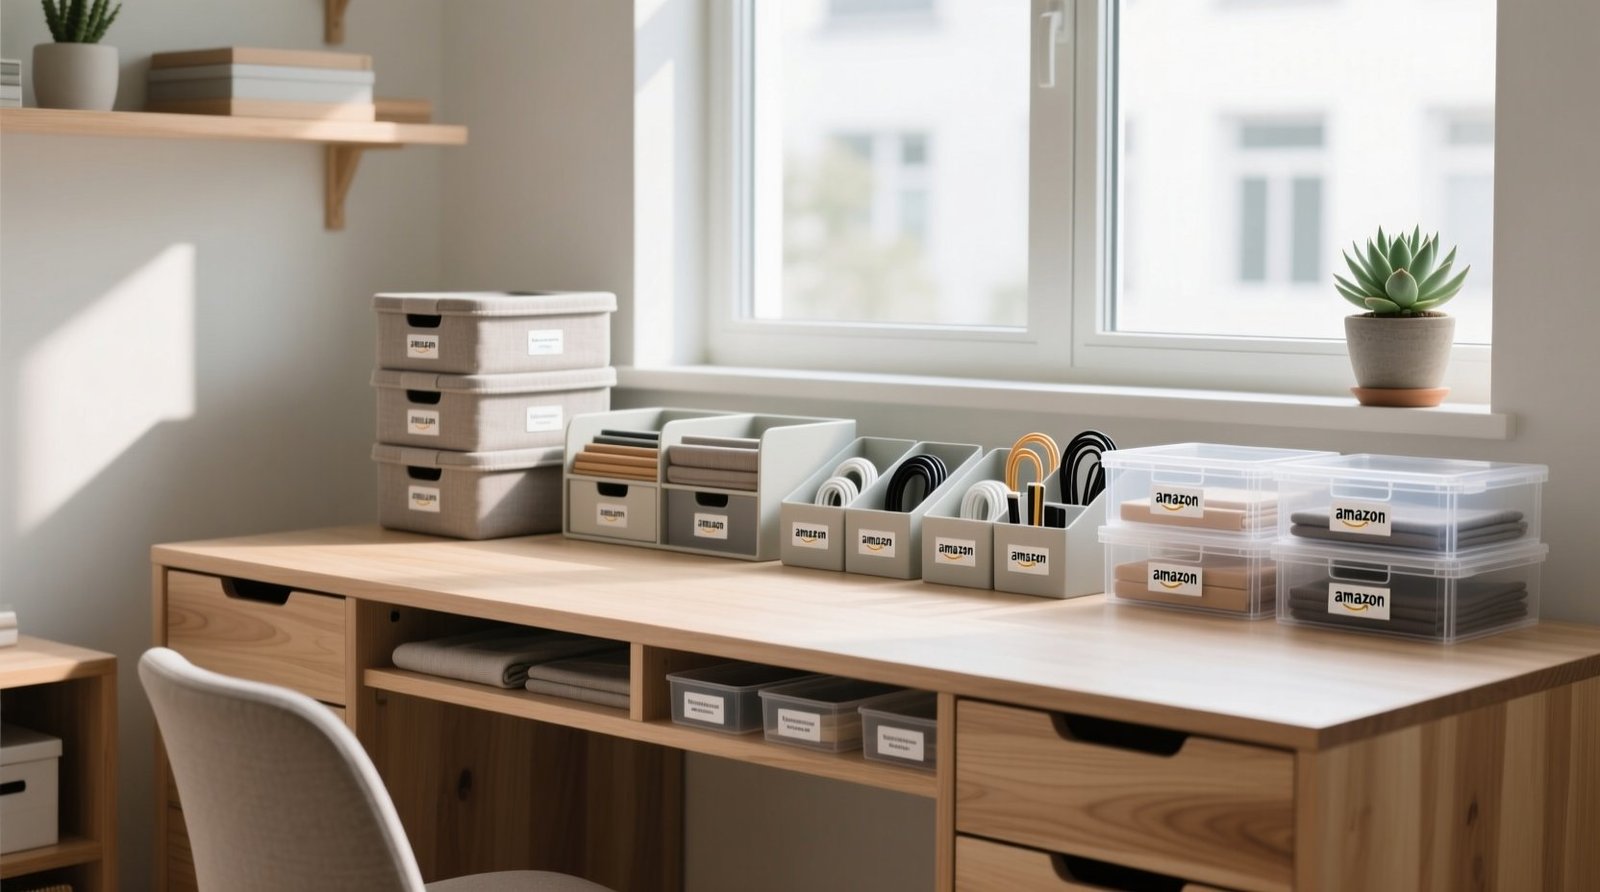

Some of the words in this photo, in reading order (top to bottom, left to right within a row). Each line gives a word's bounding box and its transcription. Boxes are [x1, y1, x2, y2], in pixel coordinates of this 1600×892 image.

[1155, 492, 1199, 507] amazon
[1335, 508, 1386, 524] amazon
[1153, 569, 1197, 585] amazon
[1334, 591, 1385, 608] amazon
